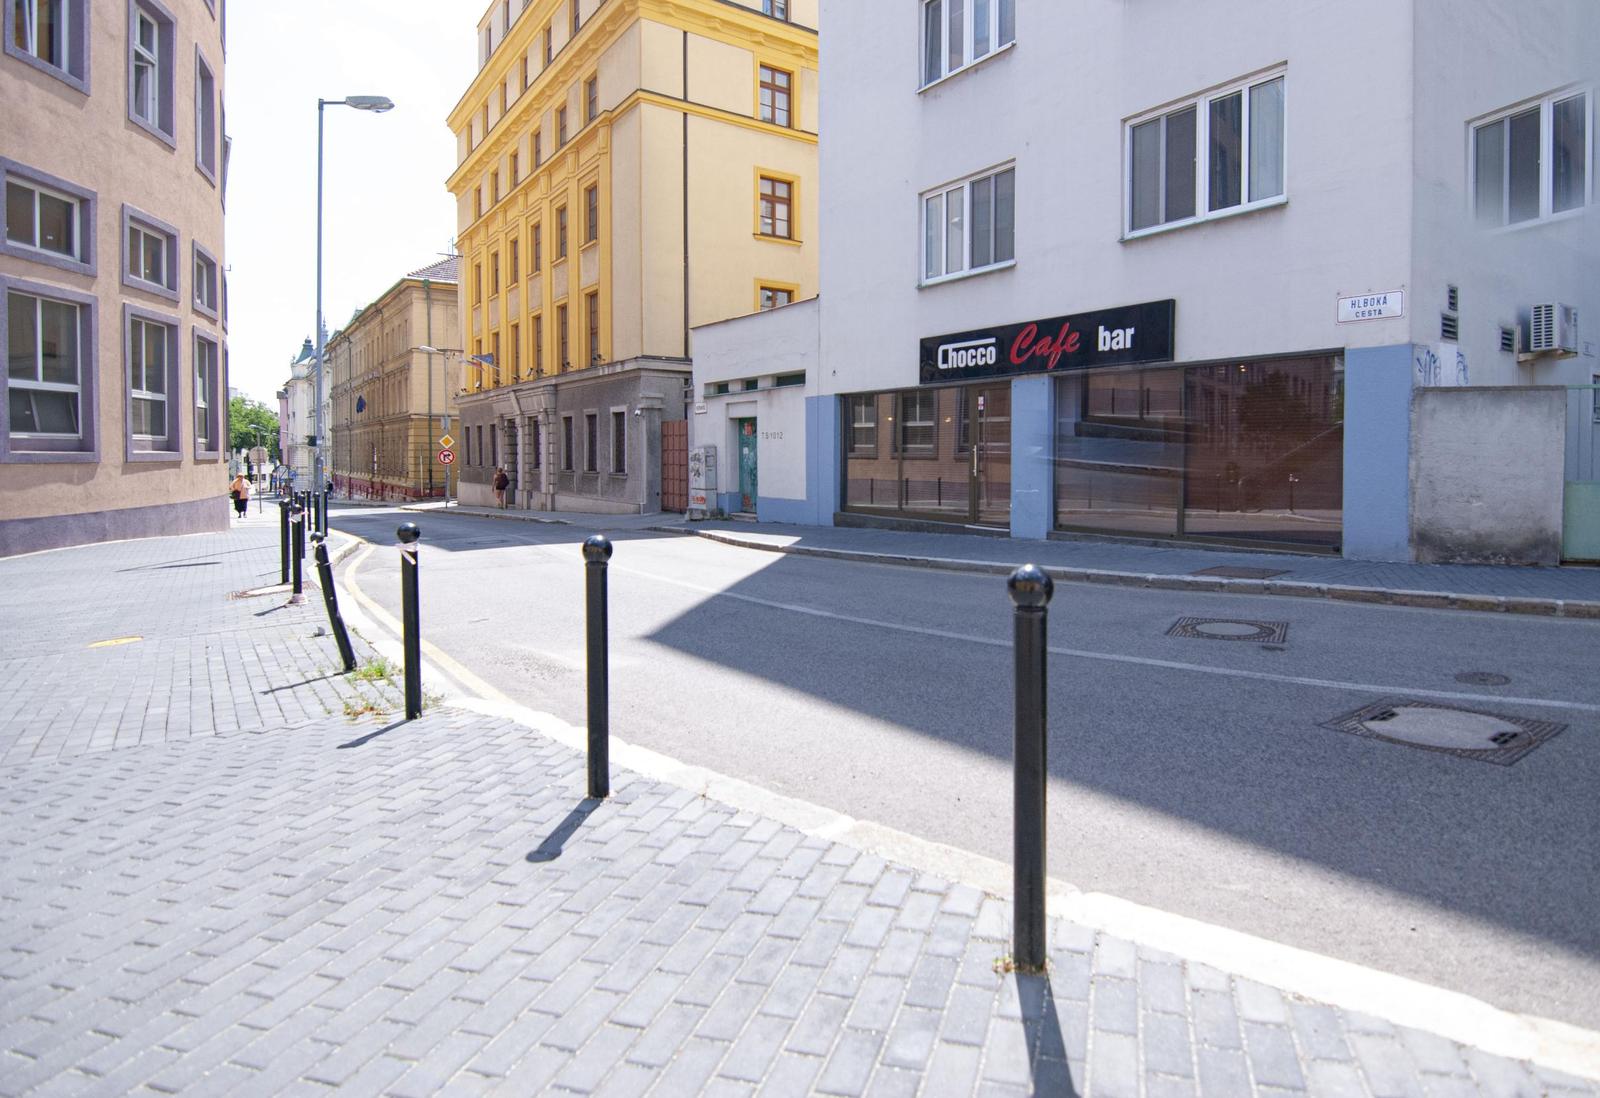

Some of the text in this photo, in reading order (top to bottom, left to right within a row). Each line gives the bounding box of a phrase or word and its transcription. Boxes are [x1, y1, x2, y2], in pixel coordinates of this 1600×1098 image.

[1355, 309, 1382, 318] CESTA
[937, 322, 1135, 369] Chocco Cafe bar
